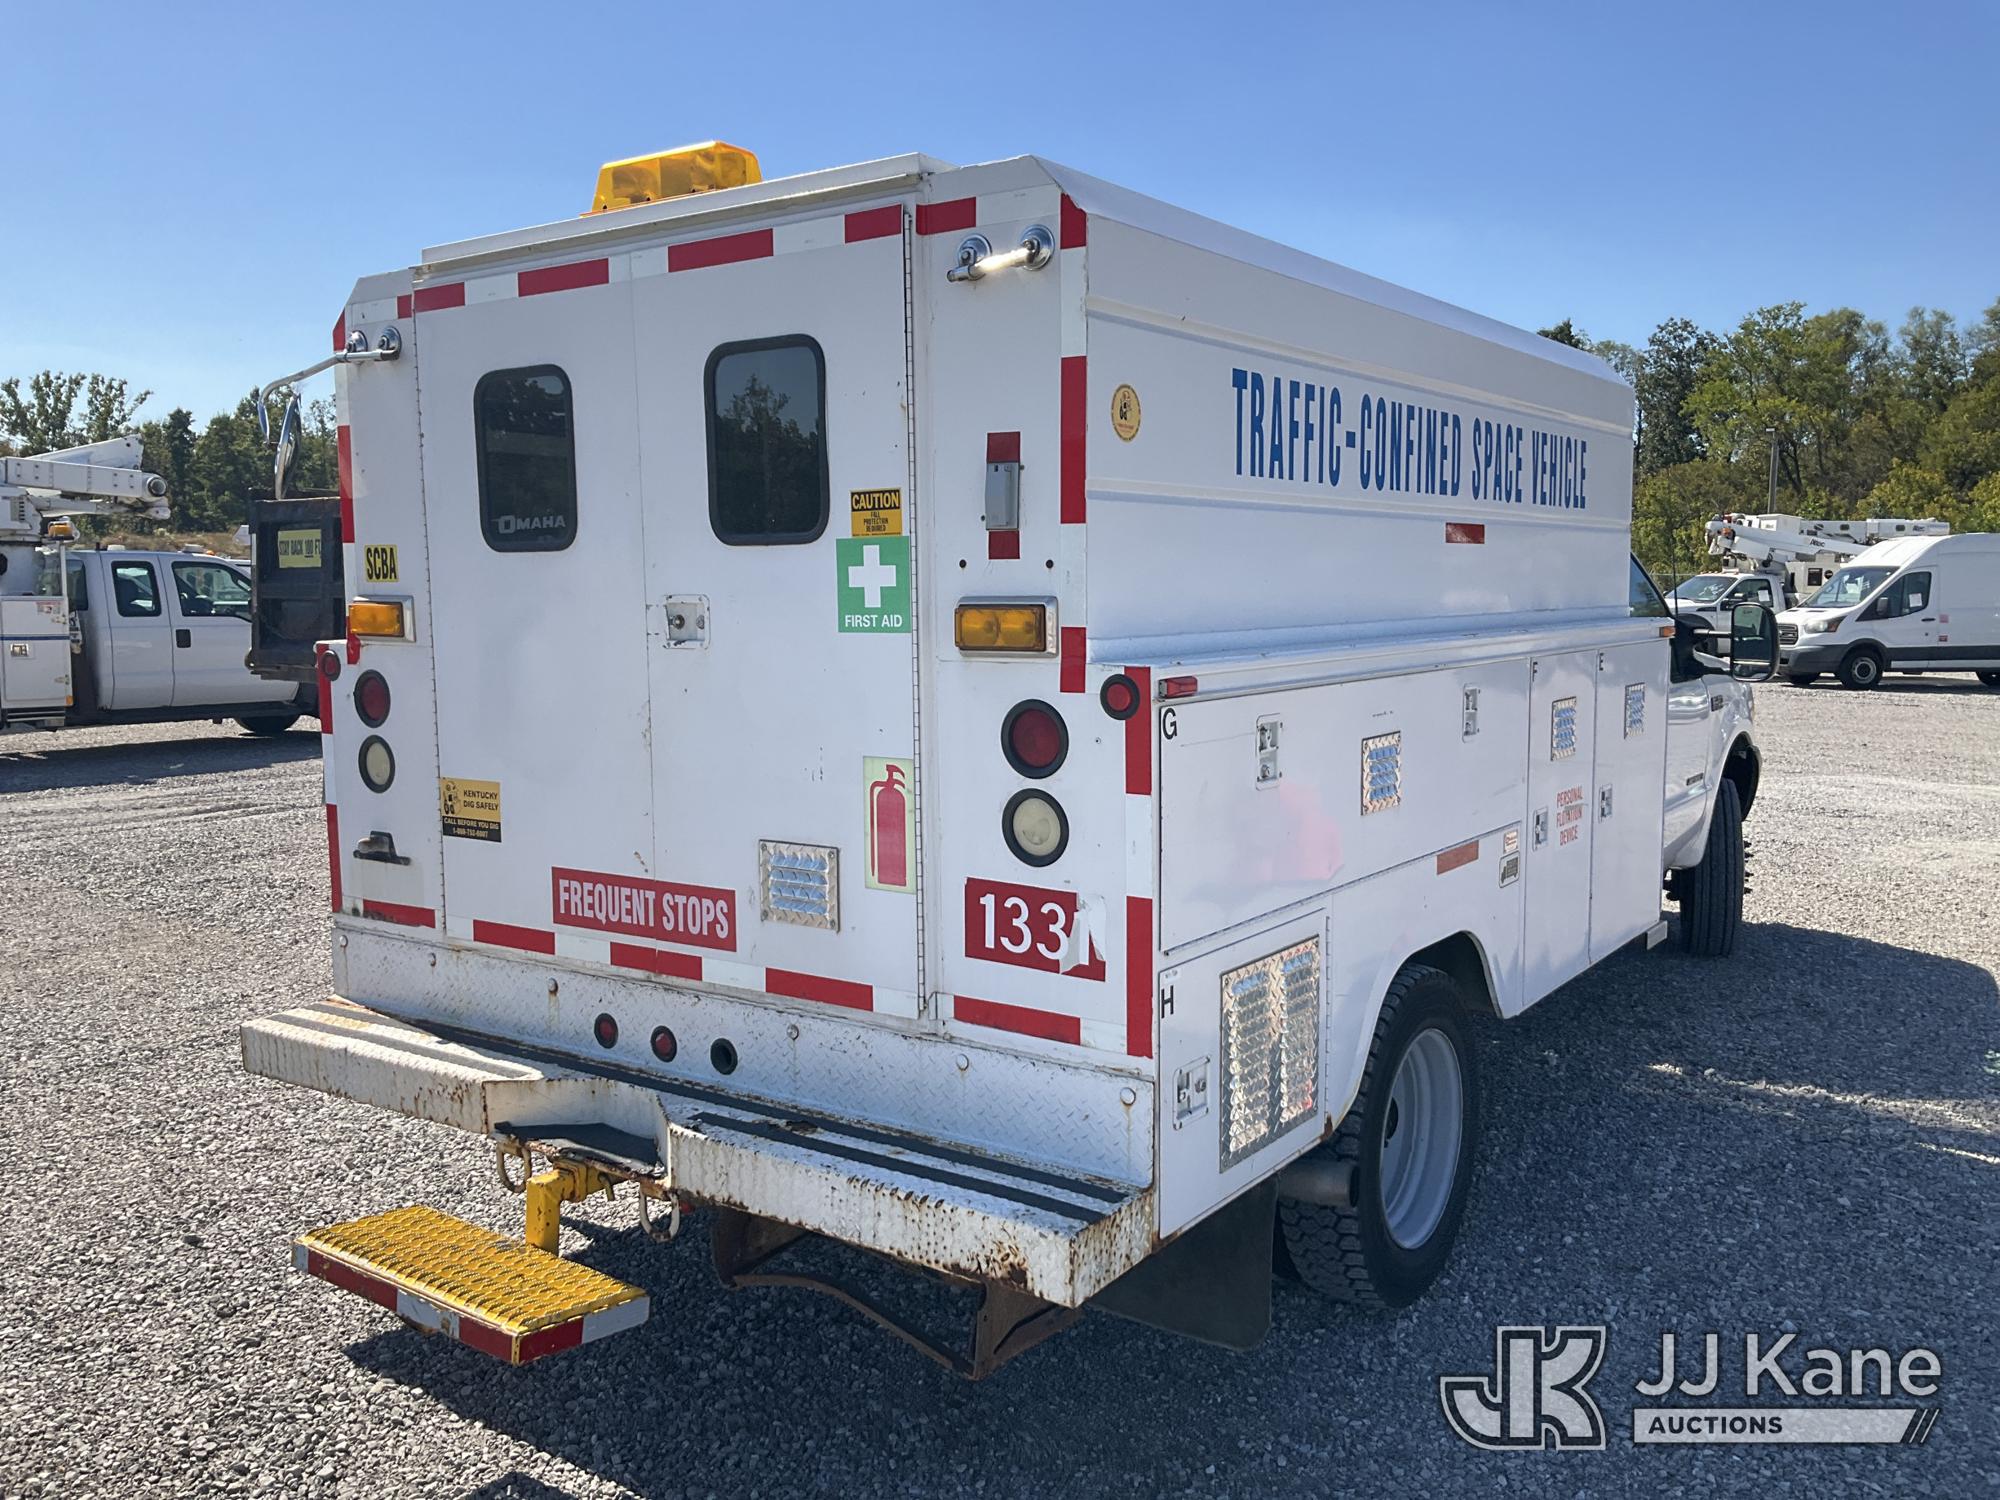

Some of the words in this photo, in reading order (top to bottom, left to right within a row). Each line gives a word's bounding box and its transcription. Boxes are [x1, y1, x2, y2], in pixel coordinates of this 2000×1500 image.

[1232, 368, 1461, 497] TRAFFIC-CONFINED
[1472, 417, 1523, 503] SPACE
[1532, 430, 1587, 509] VEHICLE
[852, 491, 899, 510] CAUTION
[366, 547, 397, 580] SCBA
[845, 614, 878, 628] FIRST
[881, 614, 903, 628] AID
[1532, 661, 1538, 682] F
[1599, 652, 1604, 671] E
[1162, 707, 1178, 740] G
[463, 800, 475, 808] DIG
[475, 800, 499, 811] SAFELY
[464, 790, 498, 800] KENTUCKY
[1556, 785, 1583, 808] PERSONAL
[443, 817, 457, 825] CALL
[457, 819, 479, 827] BEFORE
[1560, 824, 1578, 846] DEVICE
[559, 879, 656, 925] FREQUENT
[662, 892, 729, 939] STOPS
[1161, 985, 1174, 1019] H
